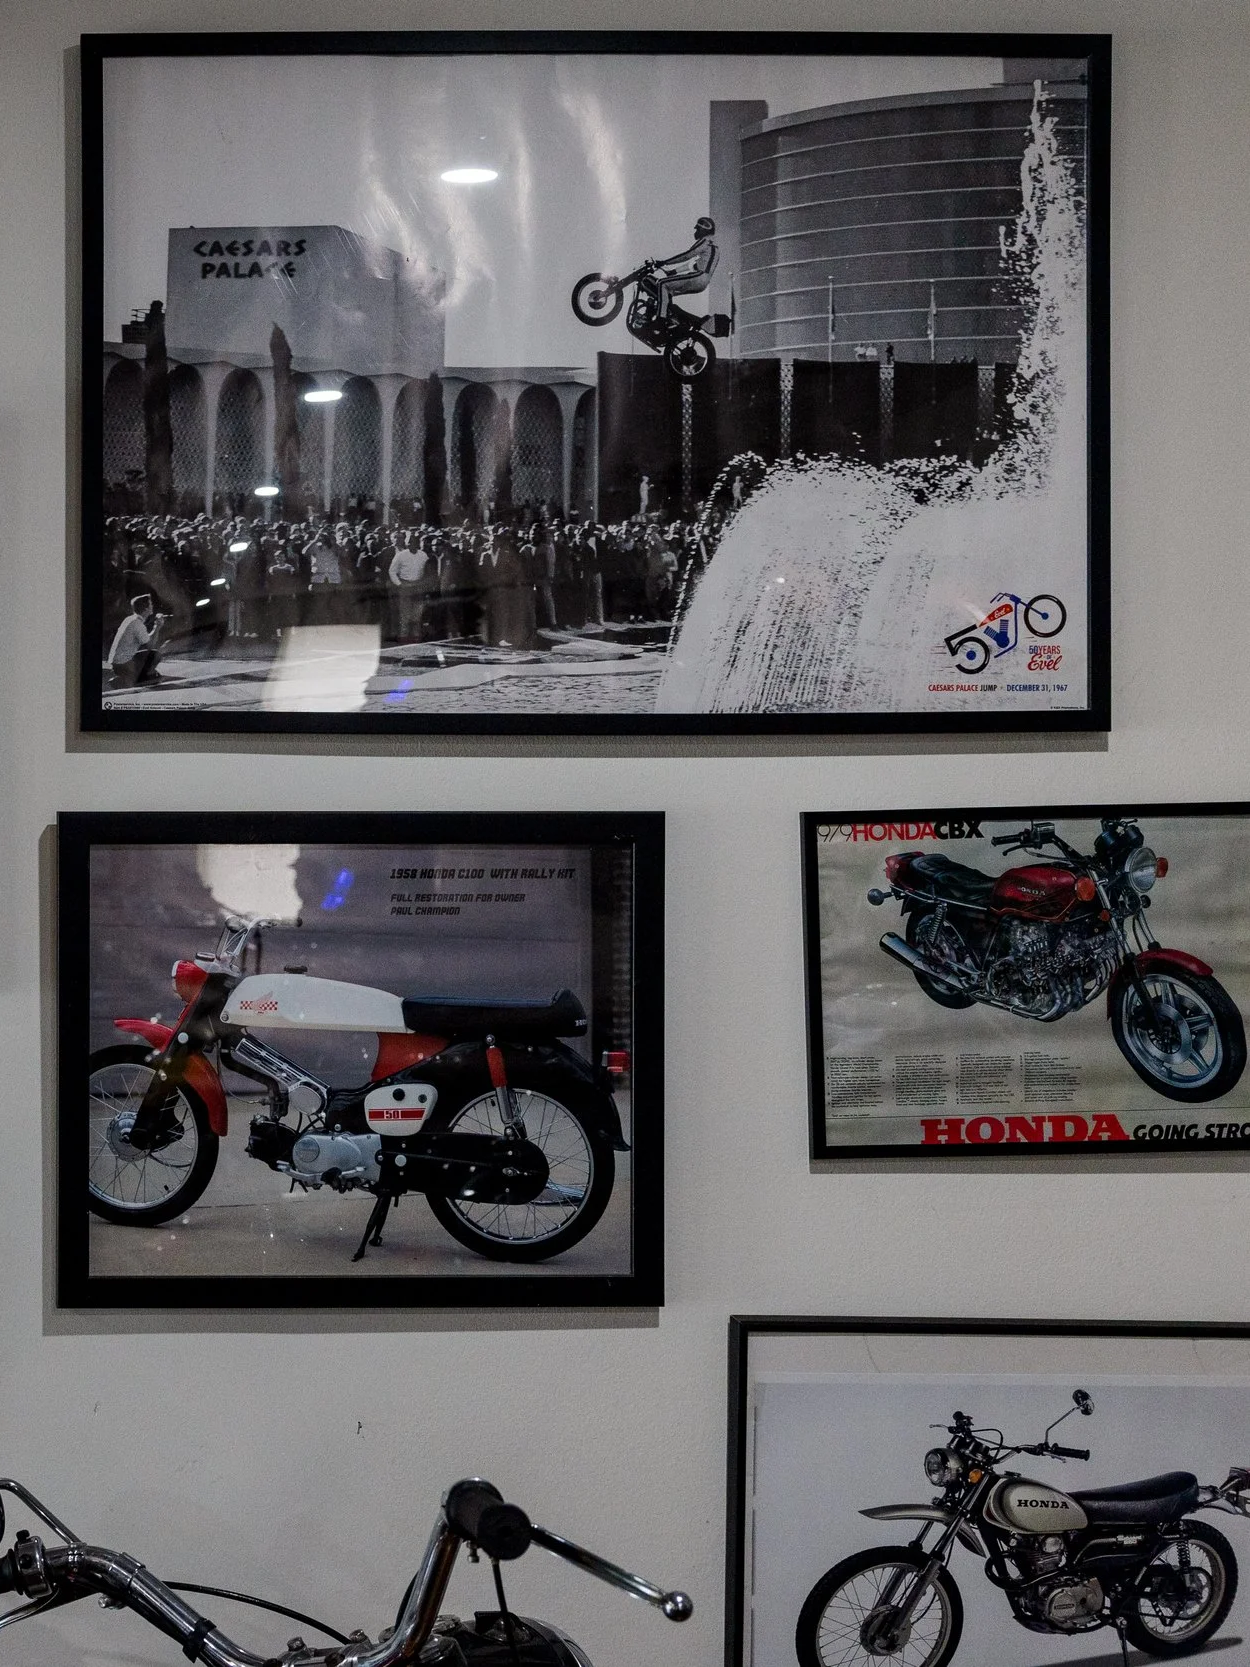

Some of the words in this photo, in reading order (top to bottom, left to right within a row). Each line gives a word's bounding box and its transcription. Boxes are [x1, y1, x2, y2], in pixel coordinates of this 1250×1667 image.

[193, 240, 307, 257] CAESARS
[1027, 654, 1063, 671] Evel
[980, 684, 998, 692] JUMP
[852, 821, 938, 842] HONDA
[934, 820, 985, 840] CBX
[390, 868, 417, 879] 1958
[419, 868, 455, 879] HONDA
[457, 868, 485, 879] C100
[490, 868, 518, 879] WITH
[520, 868, 554, 879] RALLY
[557, 868, 576, 879] KIT
[390, 893, 413, 902] FULL
[414, 893, 474, 902] RESTORATION
[475, 893, 494, 902] FOR
[495, 893, 526, 902] OWNER
[390, 907, 413, 916] PAUL
[415, 907, 461, 916] CHAMPION
[920, 1113, 1130, 1144] HONDA
[1132, 1123, 1199, 1141] GOING
[1016, 1499, 1070, 1510] HONDA
